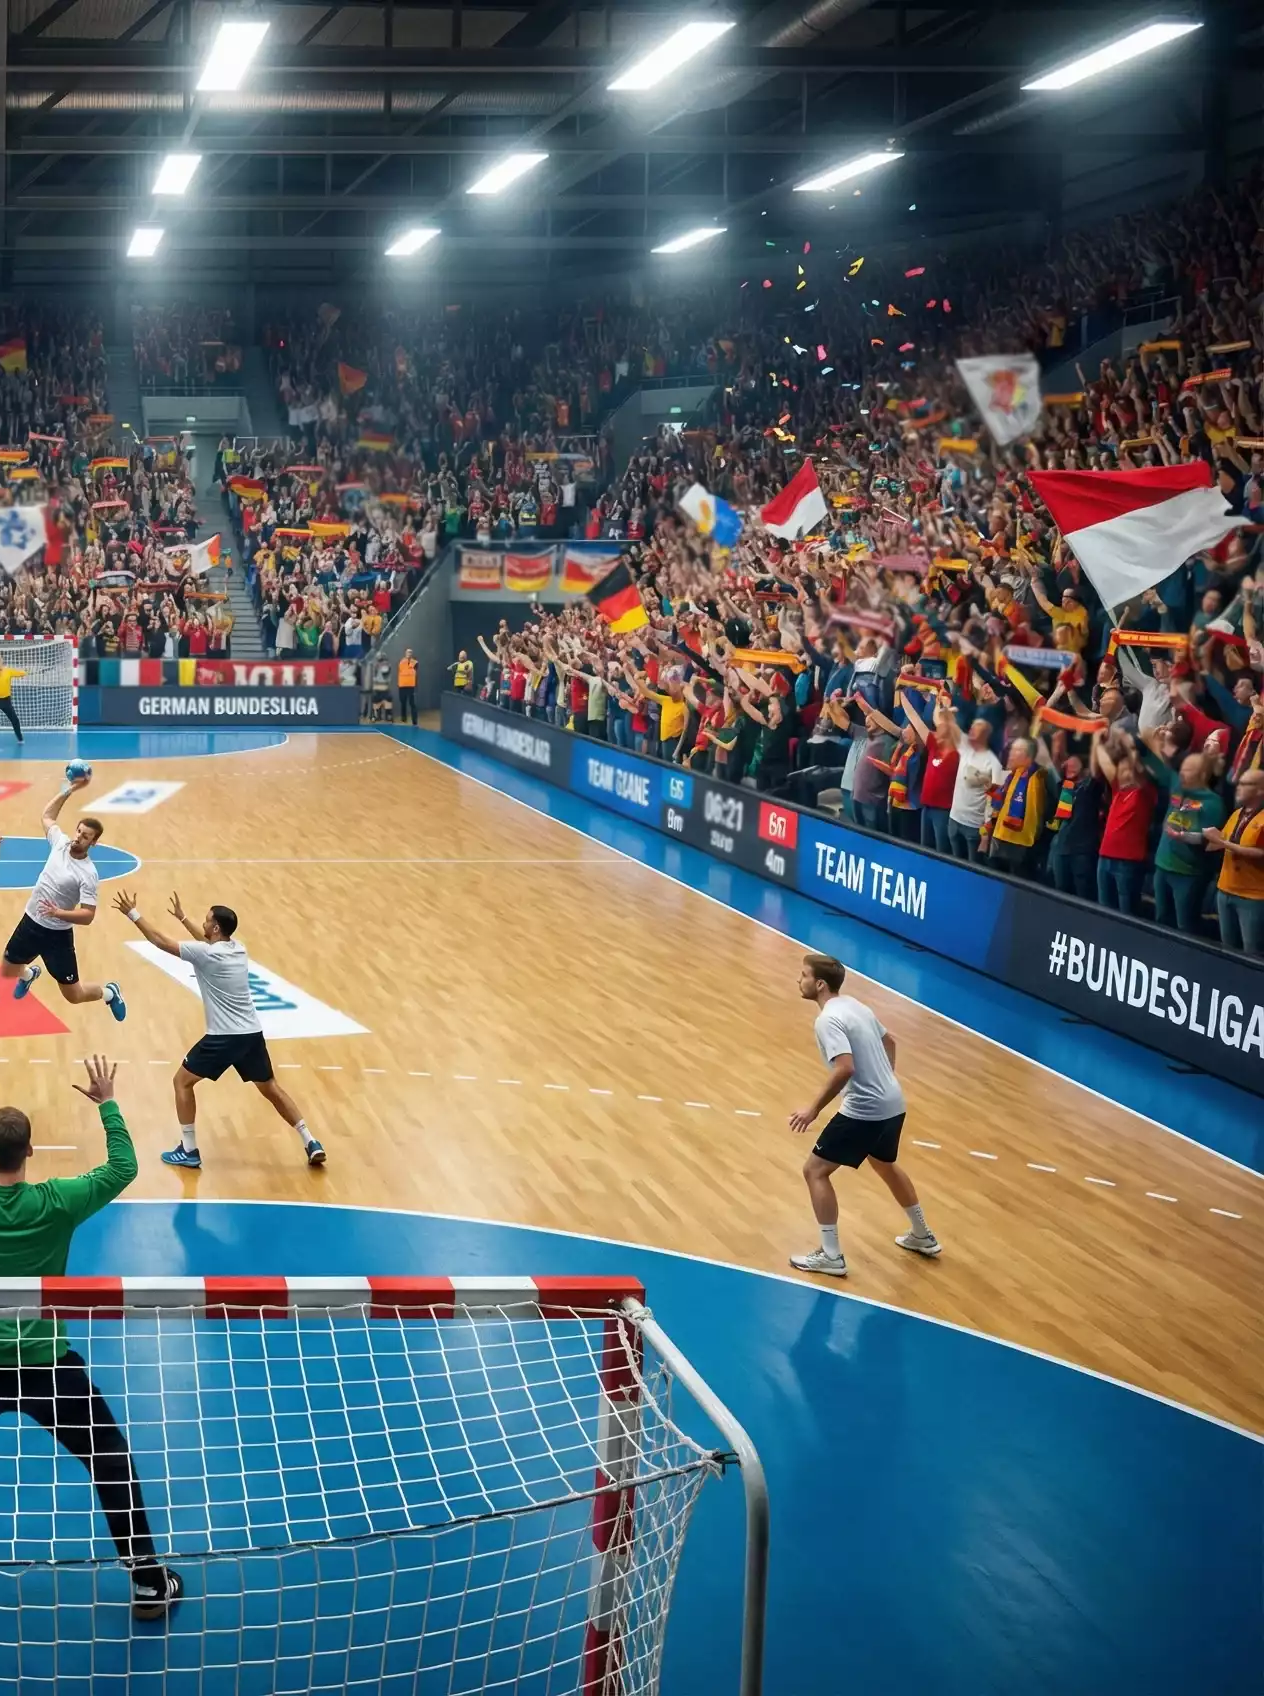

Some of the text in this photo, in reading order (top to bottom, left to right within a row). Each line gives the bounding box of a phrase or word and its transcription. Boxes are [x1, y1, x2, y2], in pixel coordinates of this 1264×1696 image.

[139, 697, 319, 716] GERMAN BUNDESLIGA
[815, 841, 927, 920] TEAM TEAM
[1048, 930, 1264, 1060] #BUNDESLIGA
